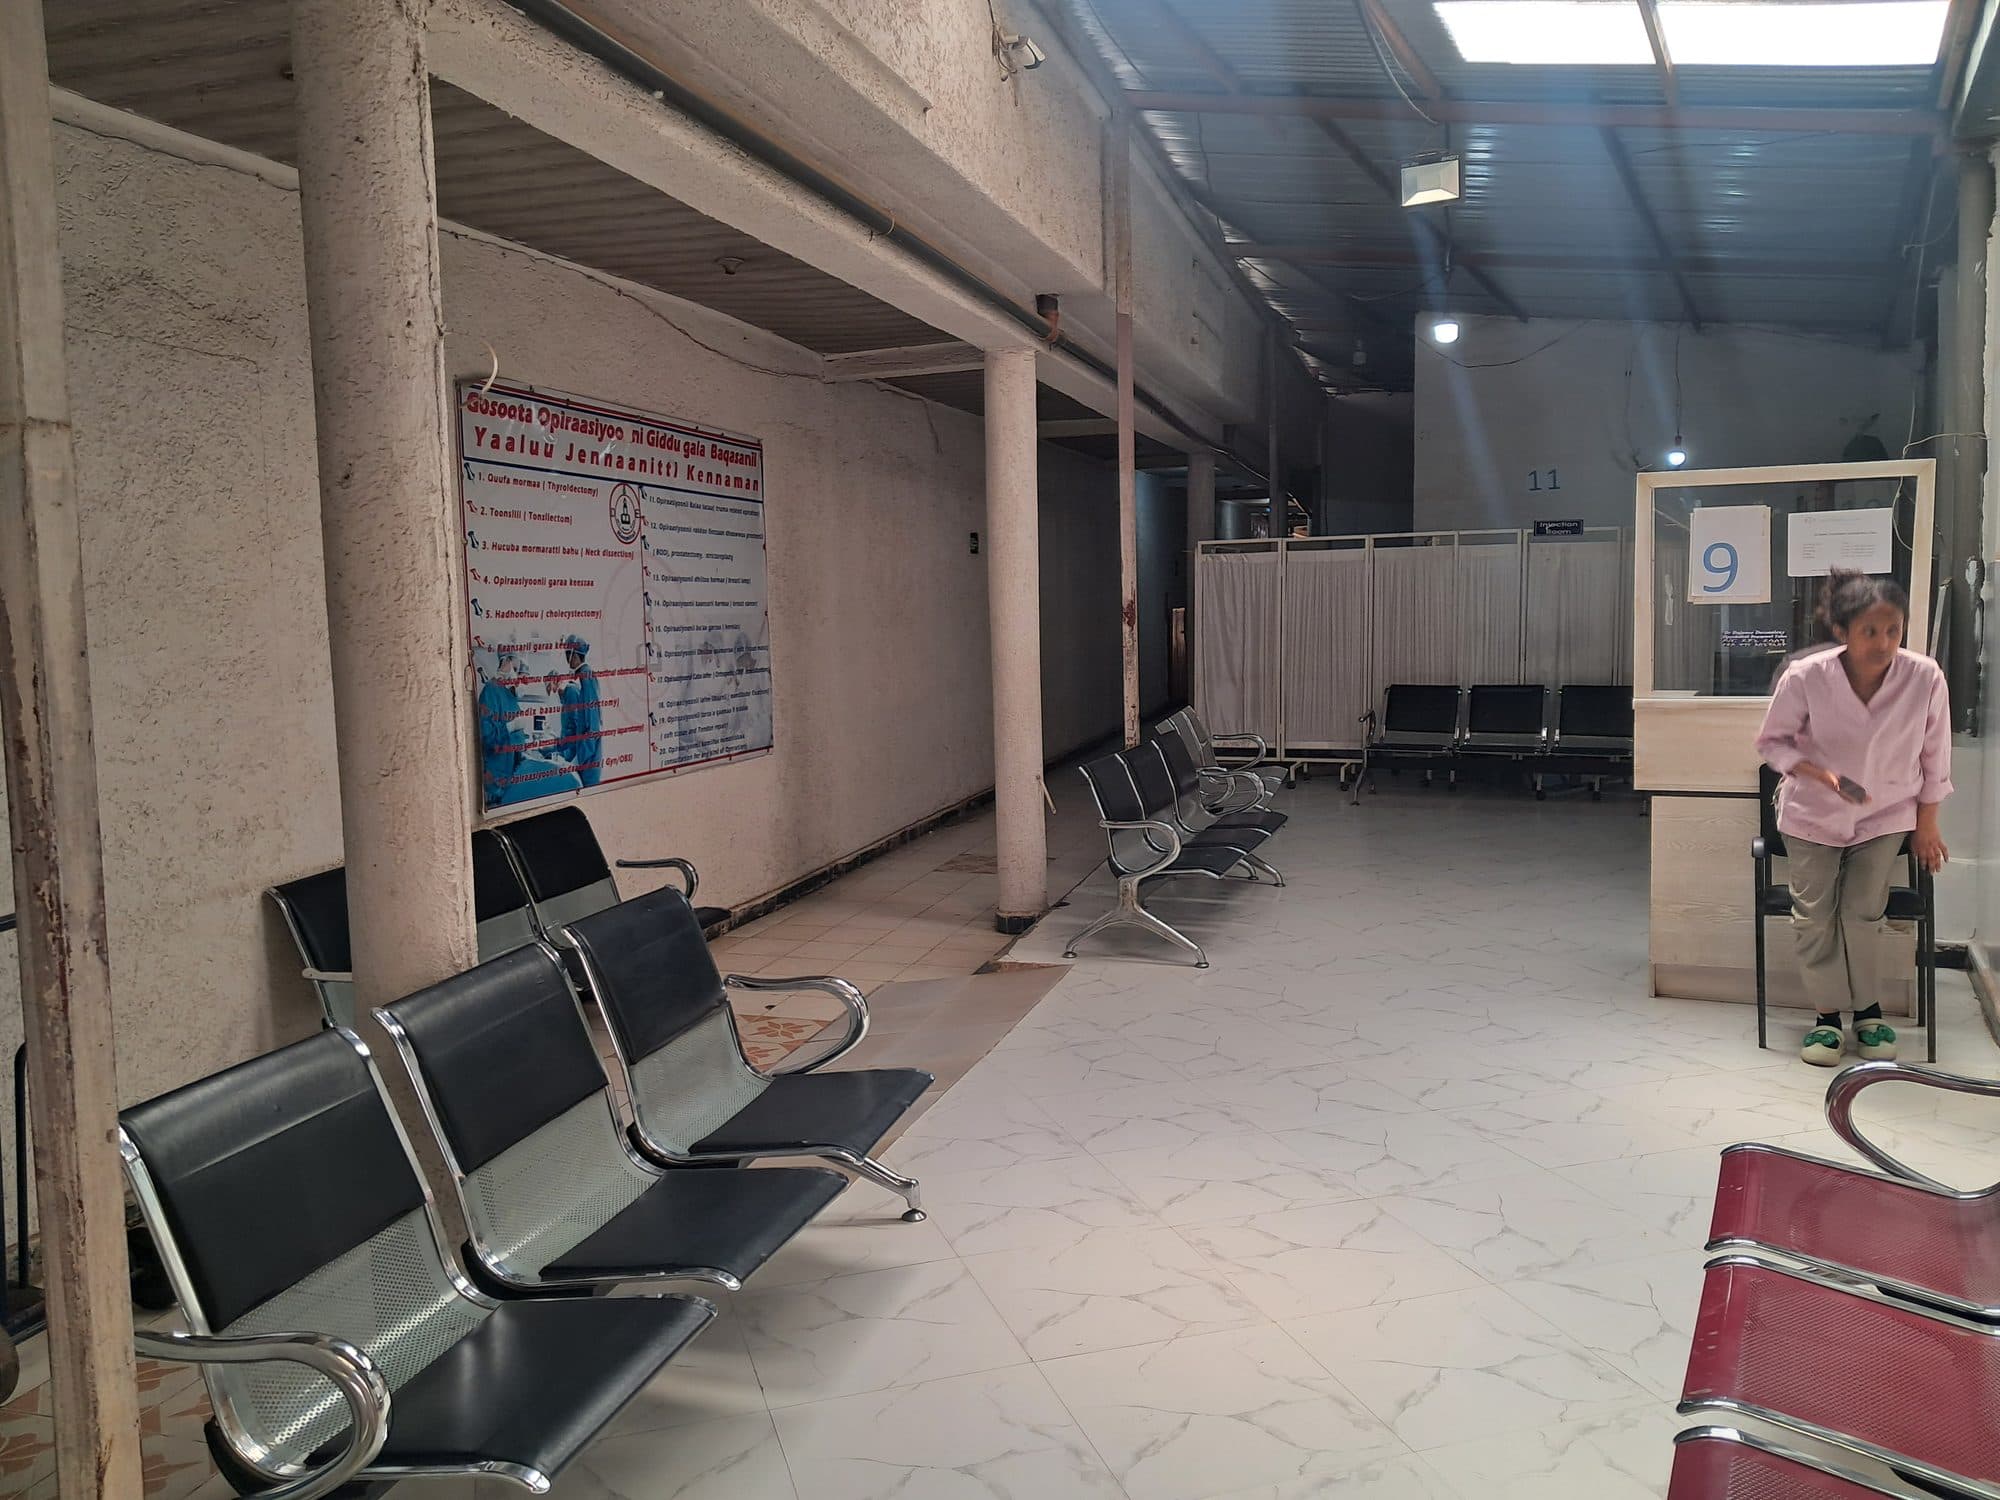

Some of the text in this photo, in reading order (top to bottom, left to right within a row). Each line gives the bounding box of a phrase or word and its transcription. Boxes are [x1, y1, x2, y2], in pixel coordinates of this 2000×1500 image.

[467, 392, 533, 423] Gosoota
[647, 430, 681, 452] Giddu
[683, 441, 706, 459] gala
[474, 426, 555, 459] Yaaluu
[687, 464, 759, 492] Kennaman
[1528, 469, 1560, 491] 11
[1703, 542, 1738, 593] 9
